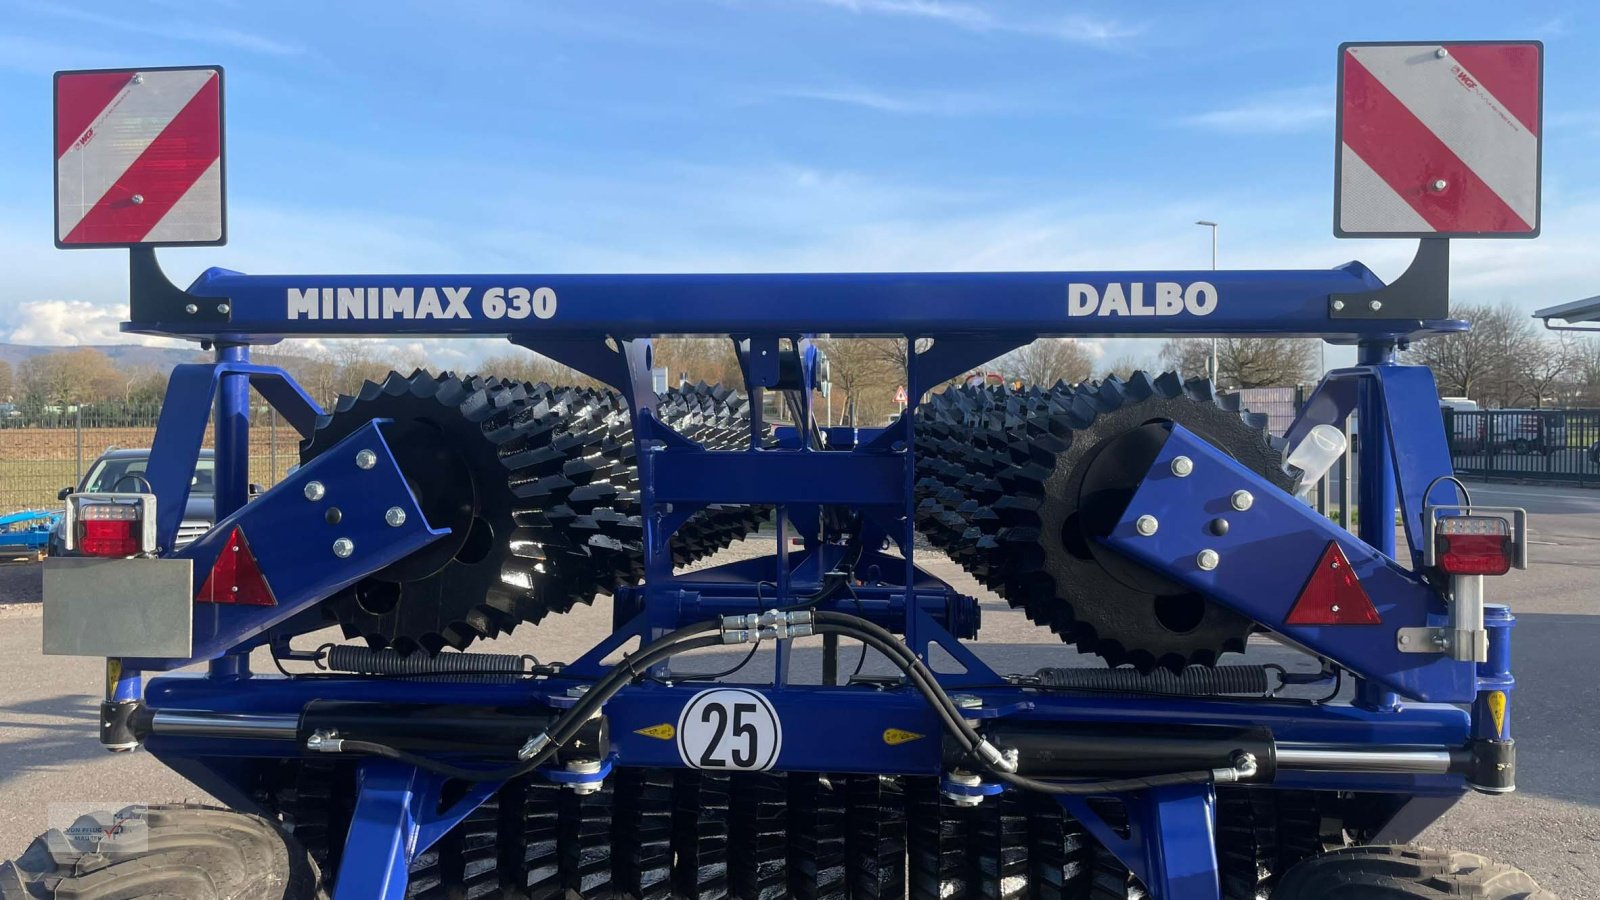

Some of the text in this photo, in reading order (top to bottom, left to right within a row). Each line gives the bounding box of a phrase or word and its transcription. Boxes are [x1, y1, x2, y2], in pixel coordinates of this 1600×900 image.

[287, 287, 557, 319] MINIMAX 630
[1068, 281, 1218, 317] DALBO
[700, 702, 758, 768] 25
